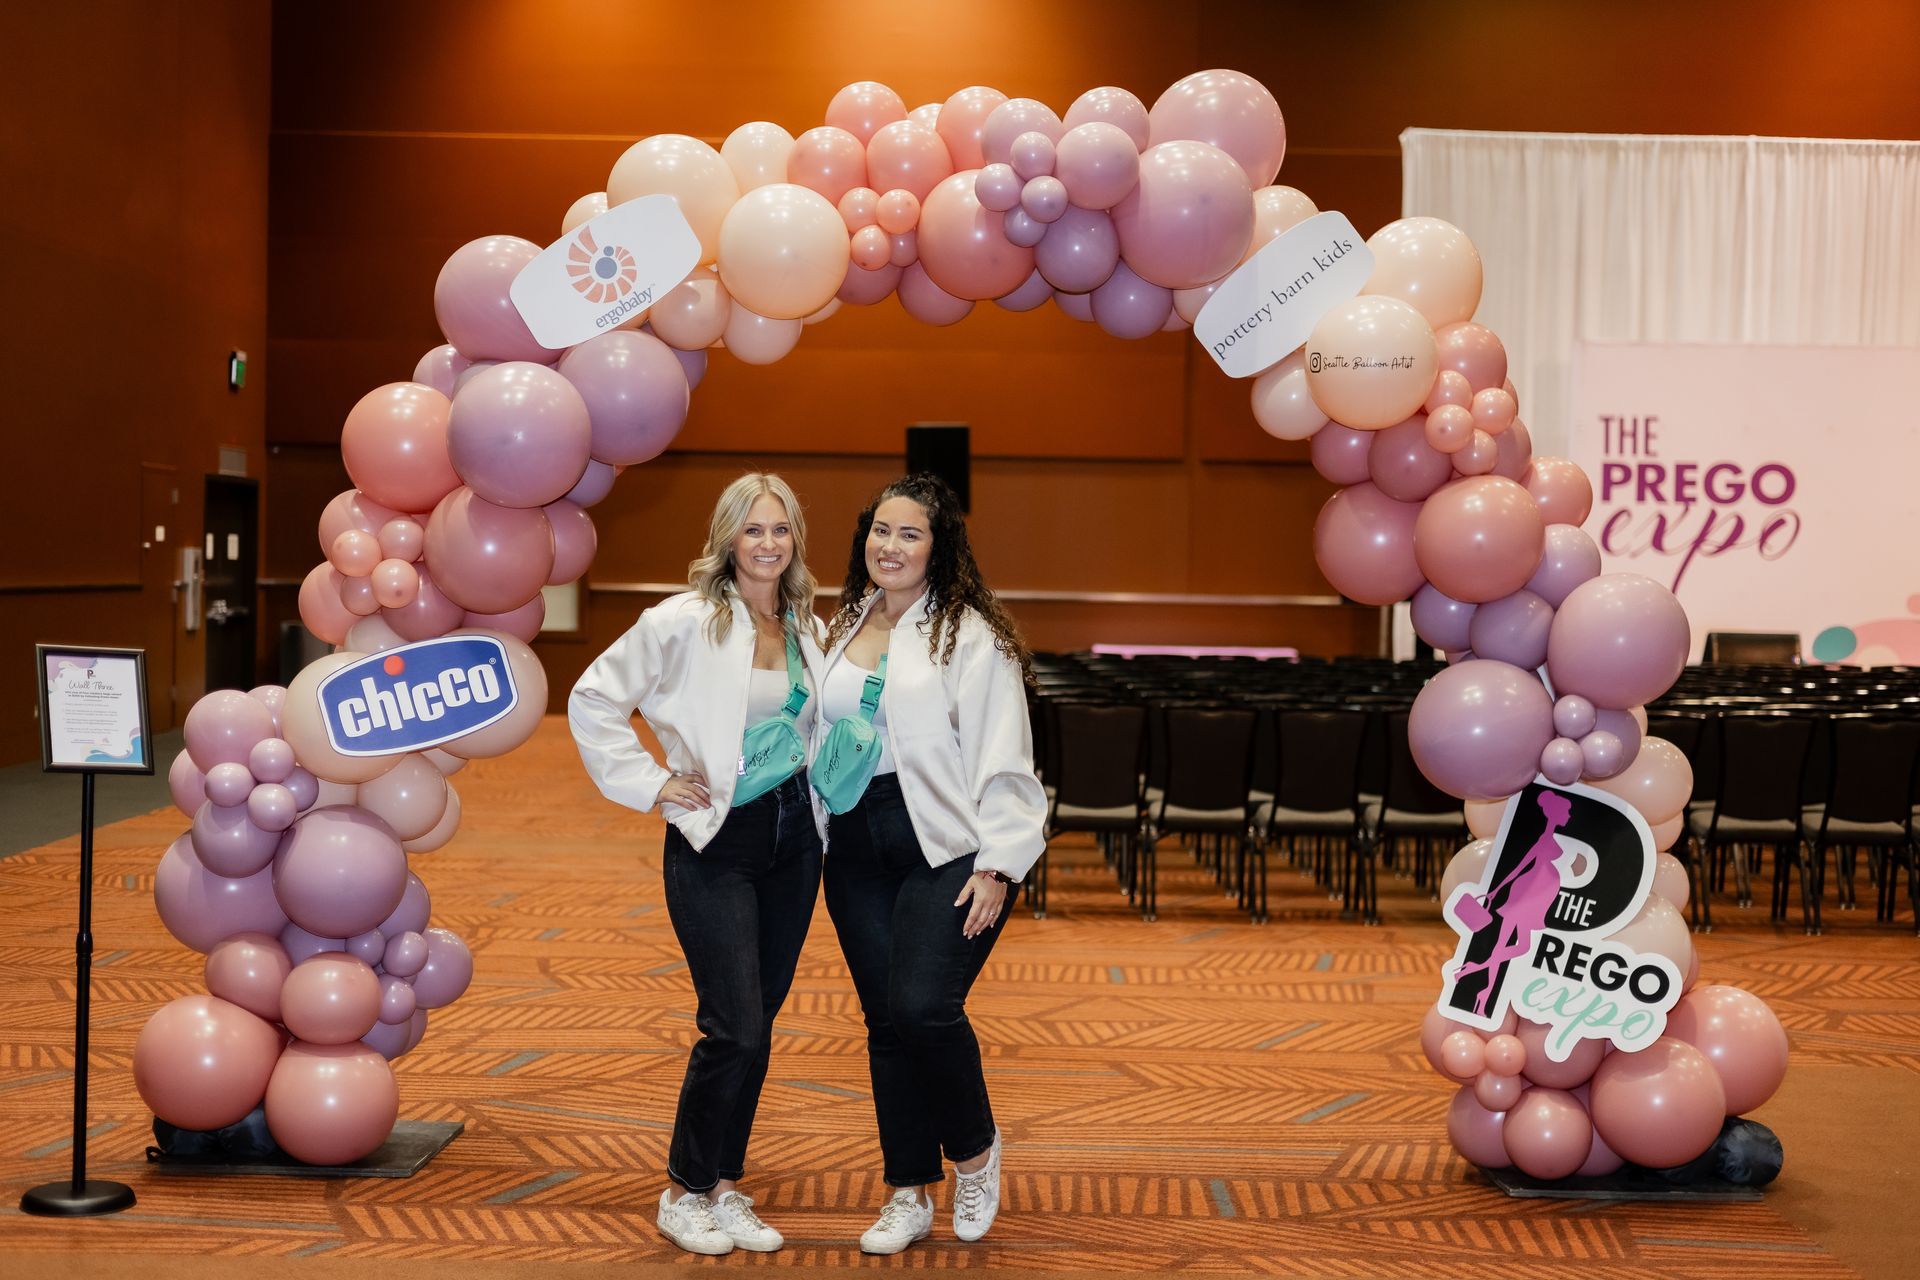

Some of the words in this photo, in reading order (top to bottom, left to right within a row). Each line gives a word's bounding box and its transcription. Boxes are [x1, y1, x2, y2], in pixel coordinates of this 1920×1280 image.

[595, 287, 653, 328] ergobaby
[1213, 303, 1274, 361] pottery
[1271, 270, 1315, 305] barn
[1312, 239, 1353, 272] kids
[1323, 355, 1350, 370] Seattle
[1352, 356, 1388, 370] Balloon
[1391, 355, 1416, 370] Artist
[1599, 415, 1658, 456] THE
[1601, 463, 1796, 504] PREGO
[1601, 507, 1801, 594] expo
[338, 655, 500, 738] chicco
[1555, 890, 1597, 927] THE
[1521, 977, 1655, 1050] expo
